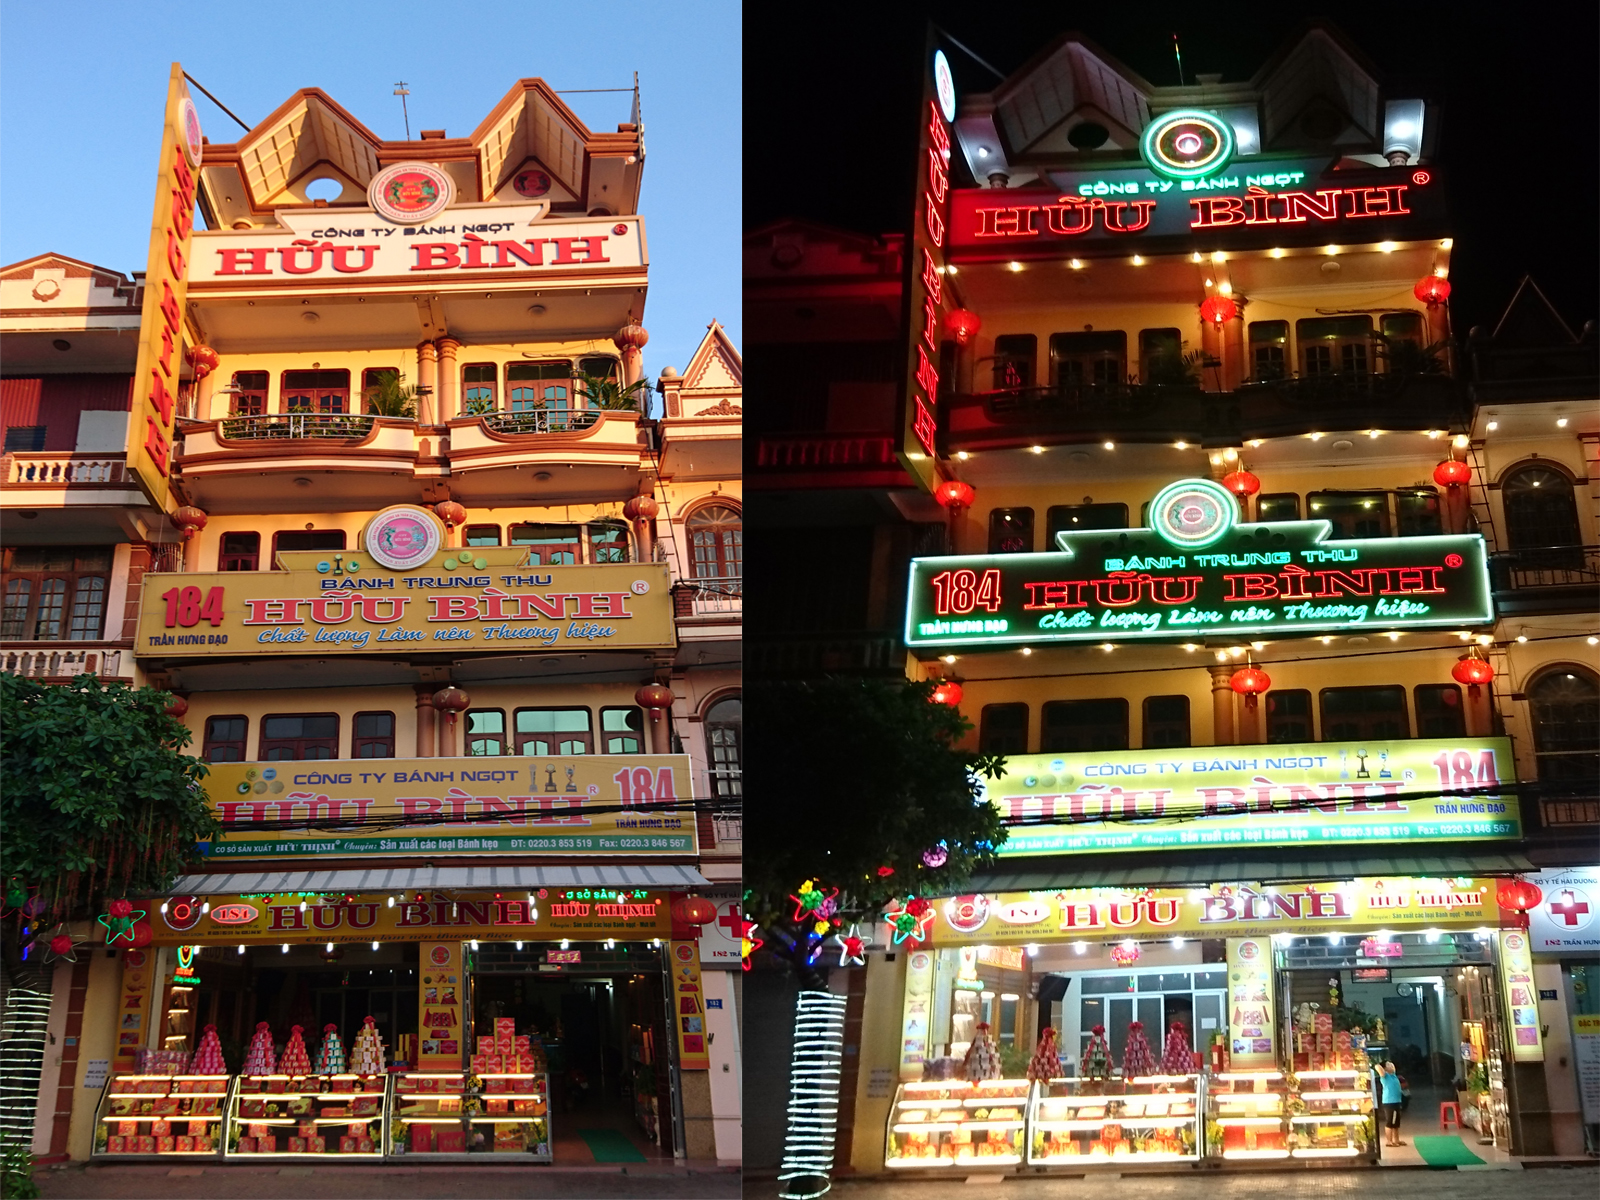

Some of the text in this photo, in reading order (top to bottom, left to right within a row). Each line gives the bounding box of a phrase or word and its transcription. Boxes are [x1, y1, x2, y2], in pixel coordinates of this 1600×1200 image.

[1078, 172, 1305, 196] CÔNG TY BÁNH NGỌT
[974, 186, 1411, 237] HỮU BÌNH
[311, 223, 514, 238] CÔNG TY BÁNH NGỌT
[214, 233, 610, 276] HỮU BÌNH
[912, 248, 941, 457] BÌNH
[145, 279, 180, 477] BÌNH
[1105, 549, 1358, 571] BÁNH TRUNG THU
[321, 574, 552, 590] BÁNH TRUNG THU
[933, 569, 1001, 615] 184
[1024, 564, 1445, 610] HỮU BÌNH
[162, 585, 226, 628] 184
[243, 587, 632, 625] HỮU BÌNH
[1038, 609, 1095, 629] Chất
[1100, 609, 1161, 633] lượng
[1230, 605, 1275, 622] nên
[1283, 601, 1367, 624] Thương
[1374, 598, 1430, 617] hiệu
[149, 632, 228, 647] TRẦN HƯNG ĐẠO
[257, 621, 617, 649] Chất lượng Làm nên Thương hiệu
[951, 621, 984, 634] HƯNG
[294, 770, 519, 785] CÔNG TY BÁNH NGỌT
[1084, 756, 1328, 777] CÔNG TY BÁNH NGỌT
[1433, 749, 1503, 800] 184
[613, 766, 678, 816] 184
[1000, 776, 1409, 827] HỮU BÌNH
[216, 787, 592, 831] HỮU BÌNH
[1460, 803, 1506, 815] HƯNG ĐẠO
[639, 819, 682, 831] HƯNG ĐẠO
[1180, 830, 1199, 843] Sản
[1201, 829, 1222, 842] xuất
[1224, 829, 1241, 841] các
[1244, 828, 1262, 842] loại
[1264, 828, 1288, 840] Bánh
[1340, 826, 1371, 837] 0220.3
[1374, 826, 1390, 836] 853
[1393, 825, 1410, 836] 519
[1418, 825, 1438, 835] Fax:
[1440, 824, 1471, 835] 0220.3
[1474, 823, 1491, 834] 846
[1493, 823, 1511, 834] 567
[226, 844, 236, 853] SỞ
[237, 843, 252, 853] SẢN
[253, 842, 272, 852] XUẤT
[380, 839, 397, 850] Sản
[399, 837, 419, 850] xuất
[420, 839, 437, 849] các
[438, 839, 455, 851] loại
[457, 839, 480, 849] Bánh
[482, 838, 499, 851] kẹo
[511, 838, 526, 848] ĐT:
[528, 838, 557, 848] 0220.3
[558, 838, 574, 848] 853
[576, 838, 592, 848] 519
[600, 838, 618, 848] Fax:
[620, 838, 649, 848] 0220.3
[651, 838, 667, 848] 846
[669, 838, 686, 848] 567
[1551, 877, 1560, 885] TẾ
[1561, 876, 1573, 885] HẢI
[576, 888, 617, 900] SỞ SẢN
[218, 908, 251, 921] 184
[267, 894, 536, 932] HỮU BÌNH
[551, 900, 657, 921] HỮU THỊNH
[1059, 887, 1353, 932] HỮU BÌNH
